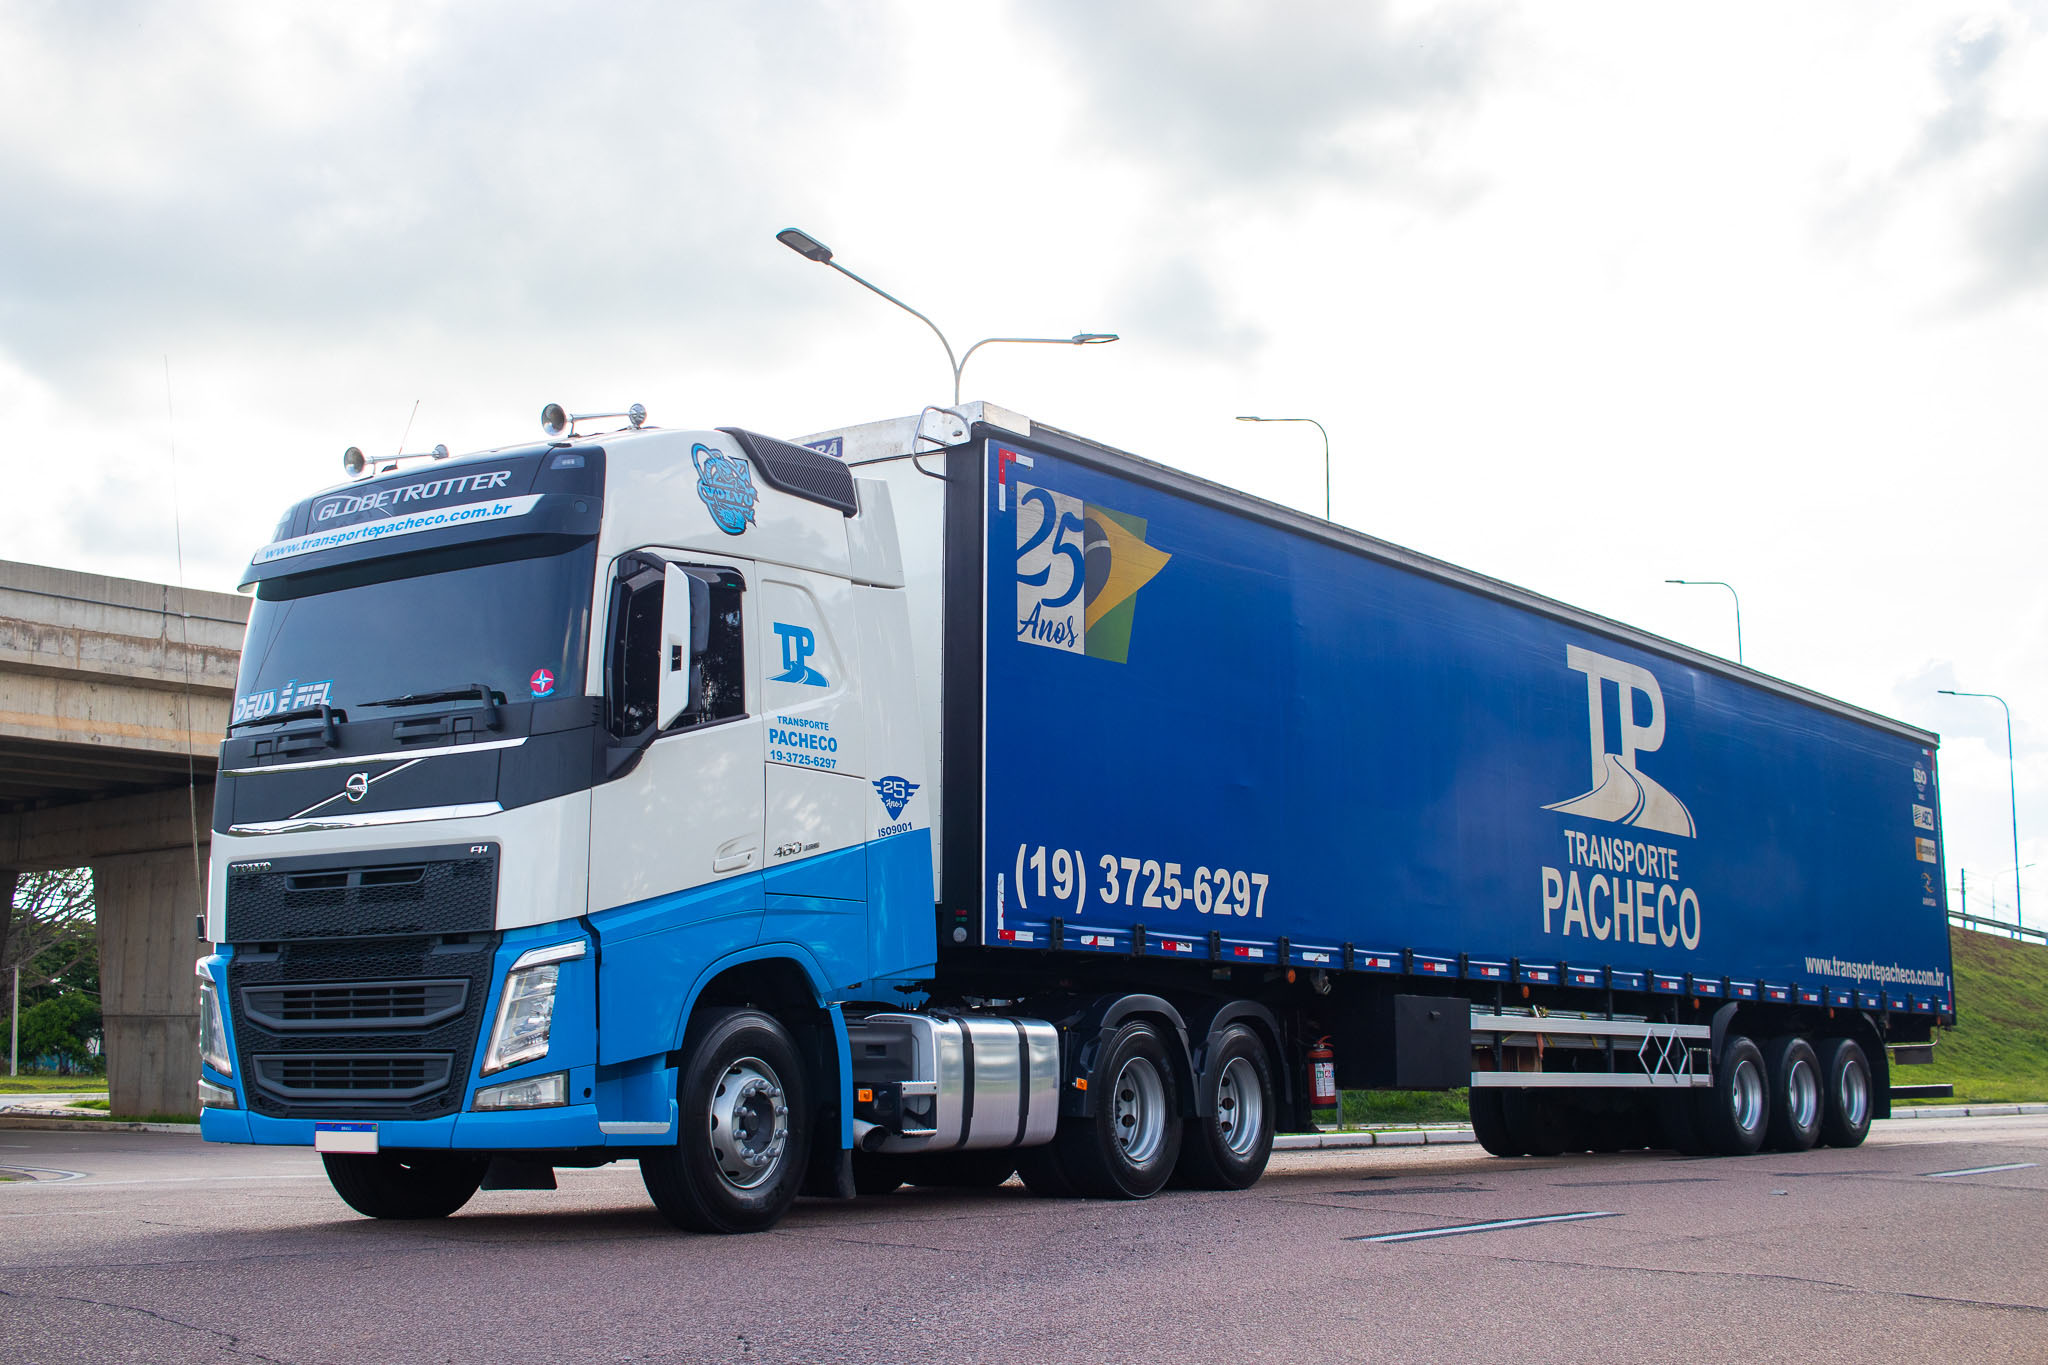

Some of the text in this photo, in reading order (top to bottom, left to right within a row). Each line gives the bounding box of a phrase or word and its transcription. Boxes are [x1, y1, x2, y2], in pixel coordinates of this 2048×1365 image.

[317, 470, 512, 522] GLOBETROTTER
[264, 503, 513, 561] www.transportepacheco.com.br
[1017, 487, 1085, 608] 25
[1017, 601, 1079, 648] Anos
[234, 682, 331, 722] DEUS É FIEL
[768, 728, 838, 753] PACHECO
[777, 715, 829, 731] TRANSPORTE
[770, 750, 837, 769] 19-3725-6297
[1912, 767, 1928, 785] ISO
[883, 780, 906, 799] 25
[877, 821, 913, 838] ISO9001
[1563, 829, 1680, 881] TRANSPORTE
[1015, 843, 1270, 919] (19) 3725-6297
[1541, 866, 1701, 951] PACHECO
[1804, 955, 1946, 987] www.transportepacheco.com.br
